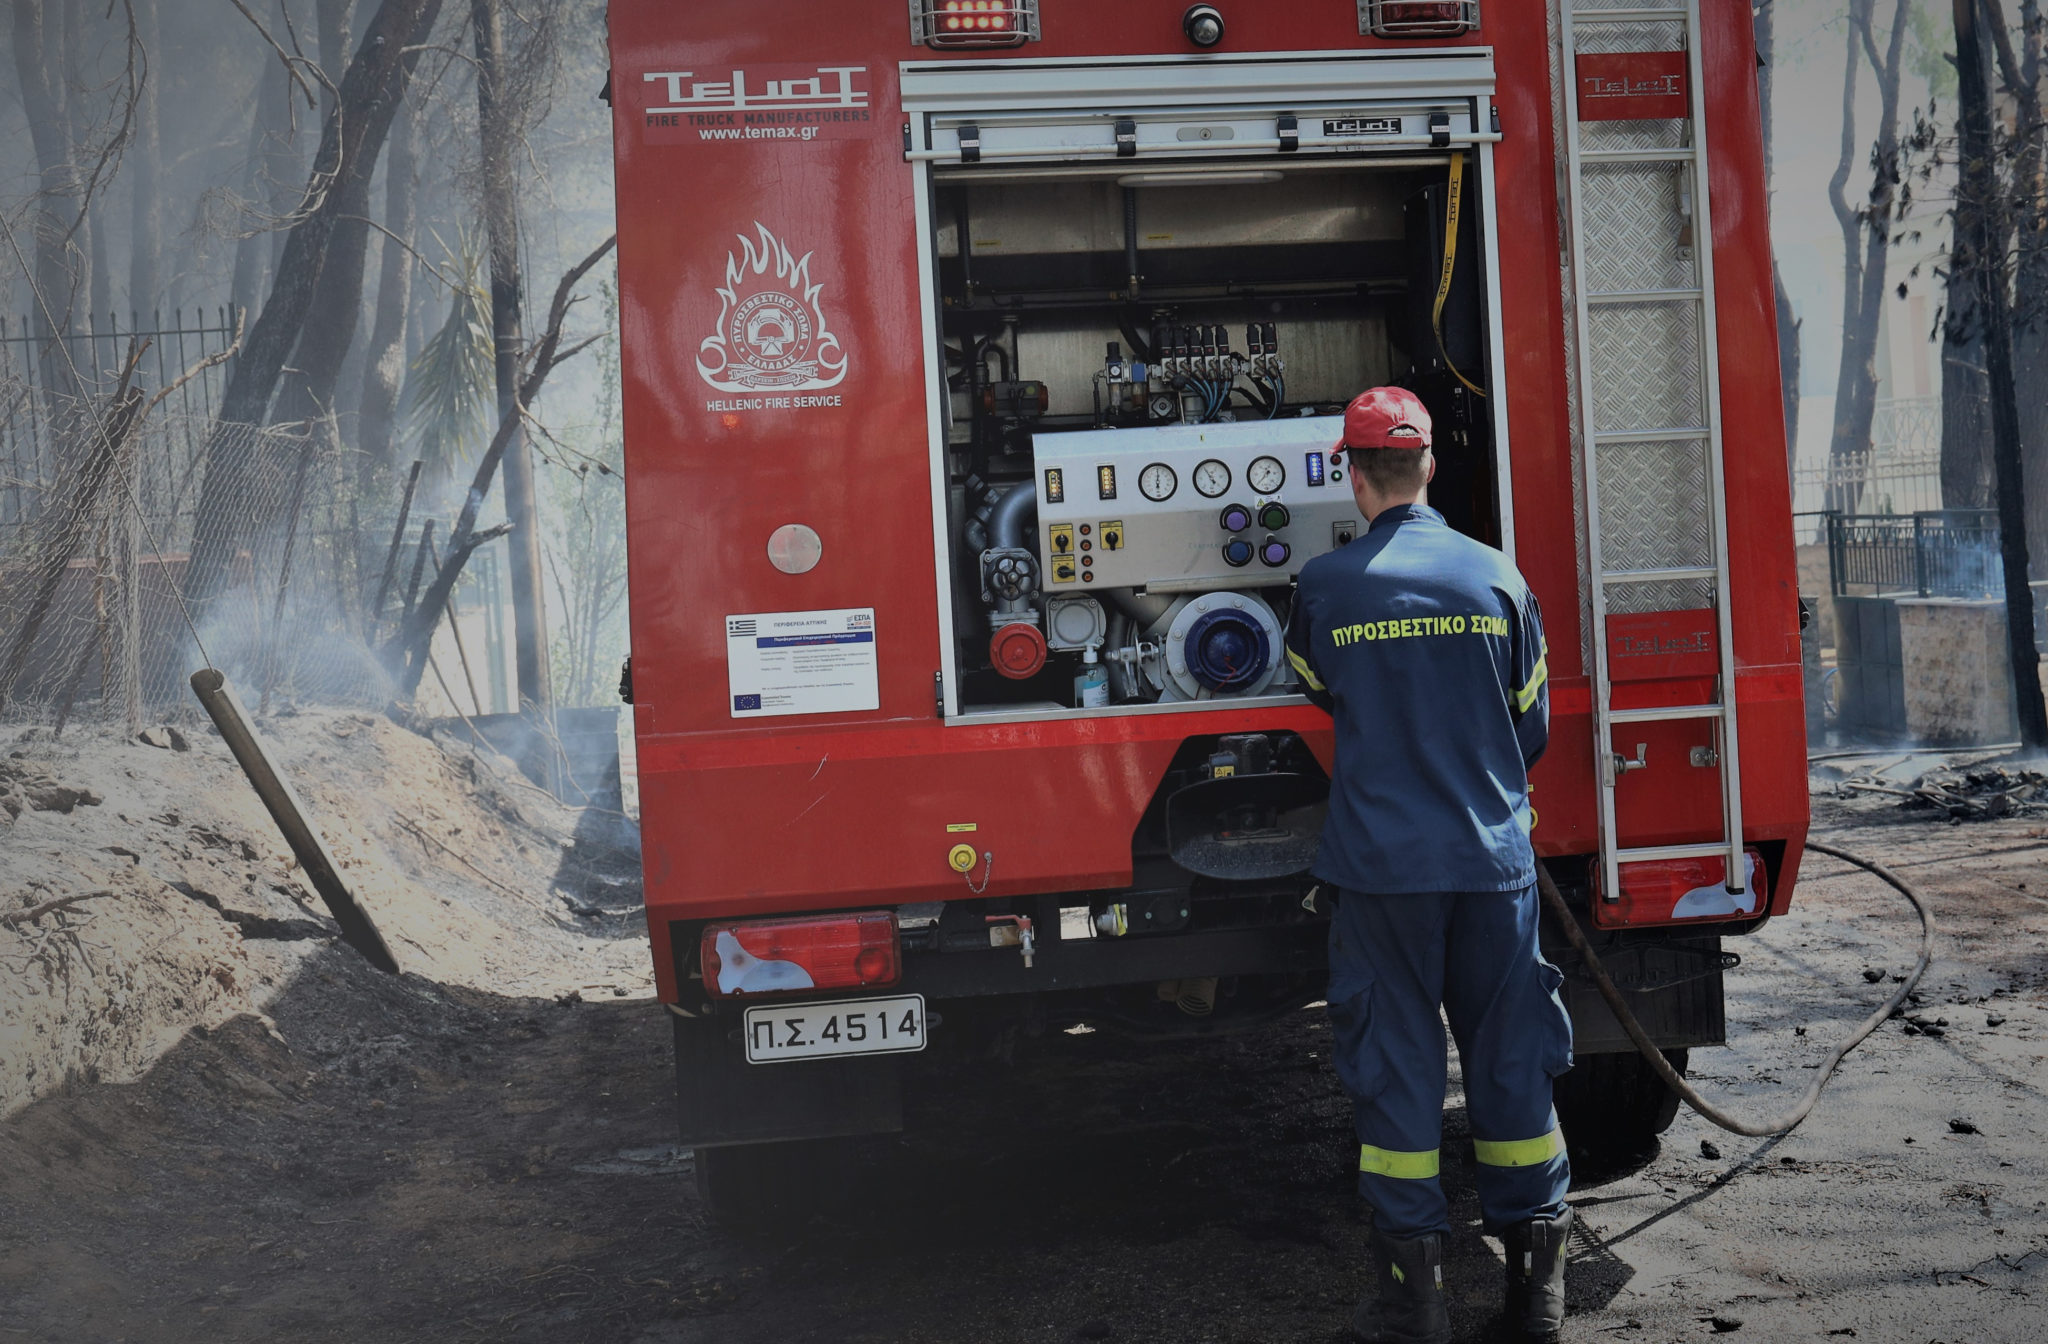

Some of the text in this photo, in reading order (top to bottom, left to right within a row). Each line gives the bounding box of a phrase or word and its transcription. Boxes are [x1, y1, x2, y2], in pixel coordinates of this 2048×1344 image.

[647, 110, 870, 127] FIRE TRUCK MANUFACTURERS
[699, 125, 819, 140] www.temax.gr
[733, 294, 809, 343] ΠΥΡΟΣΒΕΣΤΙΚΟ ΣΩΜΑ
[747, 355, 796, 370] ΕΛΛΑΔΑΣ
[707, 395, 842, 411] HELLENIC FIRE SERVICE
[1331, 615, 1509, 647] ΠΥΡΟΣΒΕΣΤΙΚΟ ΣΩΜΑ
